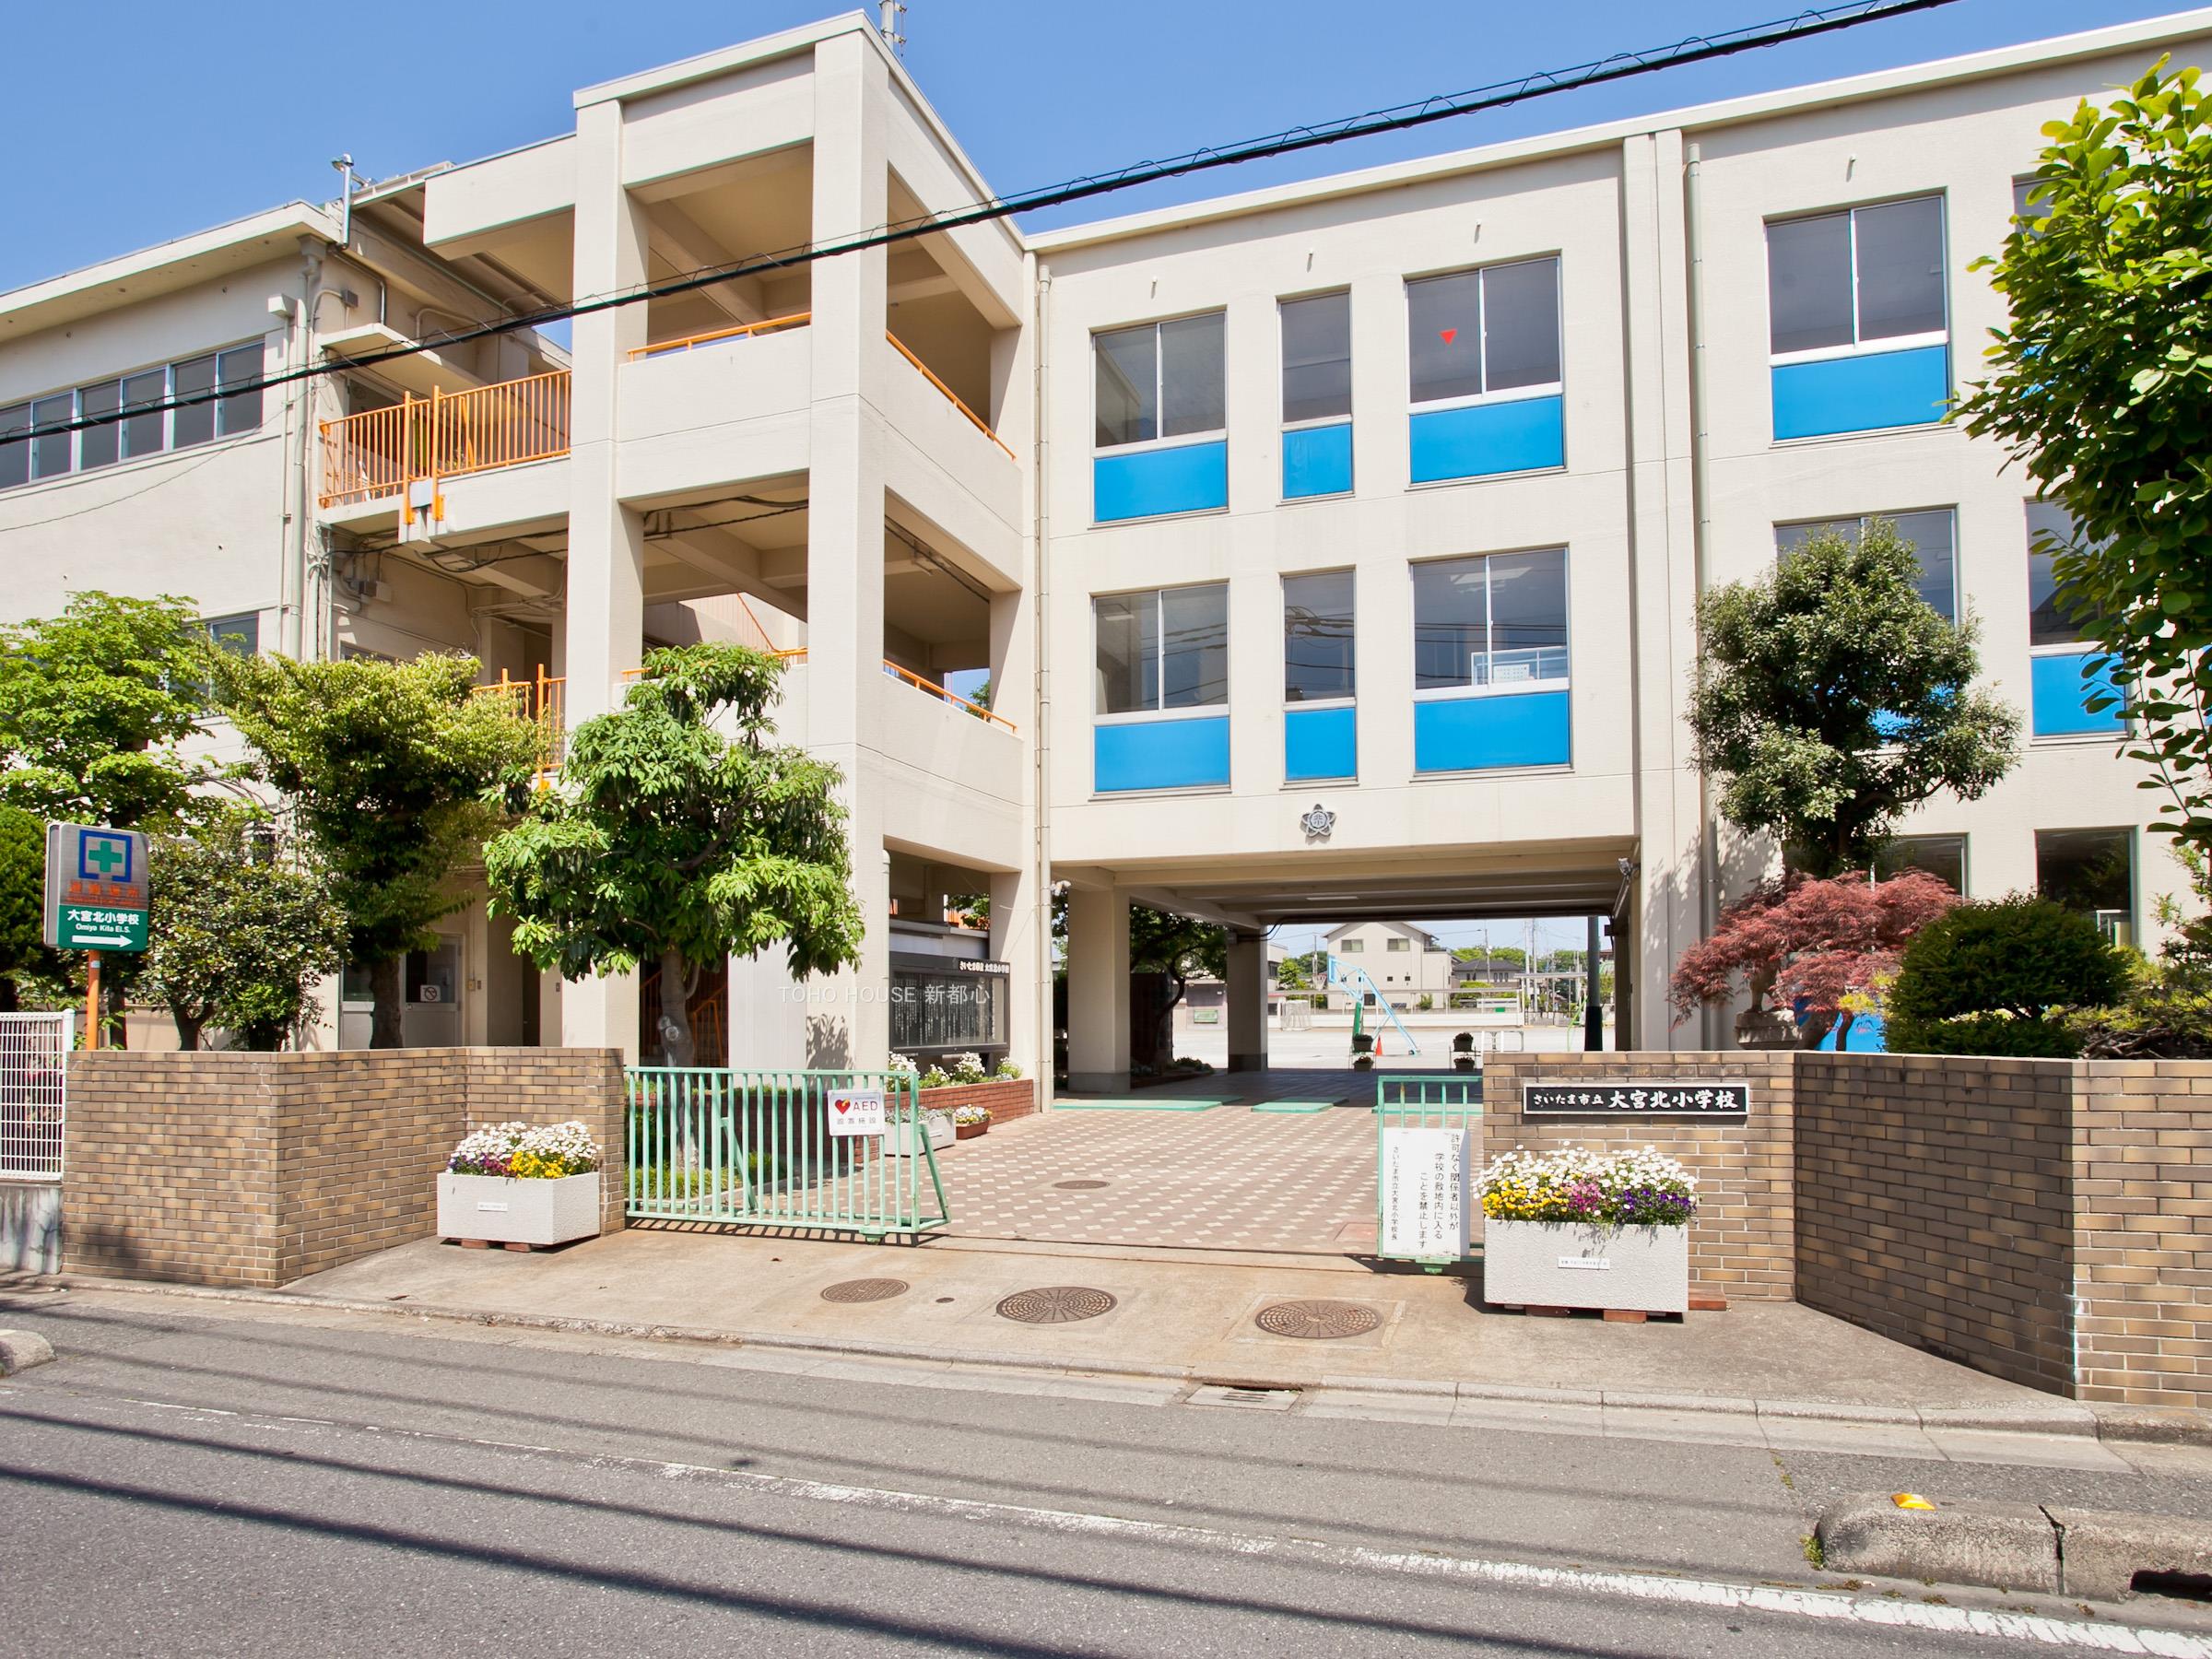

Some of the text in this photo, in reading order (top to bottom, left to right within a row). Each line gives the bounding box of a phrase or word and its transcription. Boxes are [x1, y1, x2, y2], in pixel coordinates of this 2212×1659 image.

[67, 910, 139, 925] 大宮北小学校
[76, 923, 98, 932] Omiya
[100, 924, 114, 933] Kita
[853, 1100, 878, 1112] AED
[1533, 1089, 1739, 1110] さいたま市立 大宮北小学校
[1419, 1172, 1429, 1248] ことを禁止します
